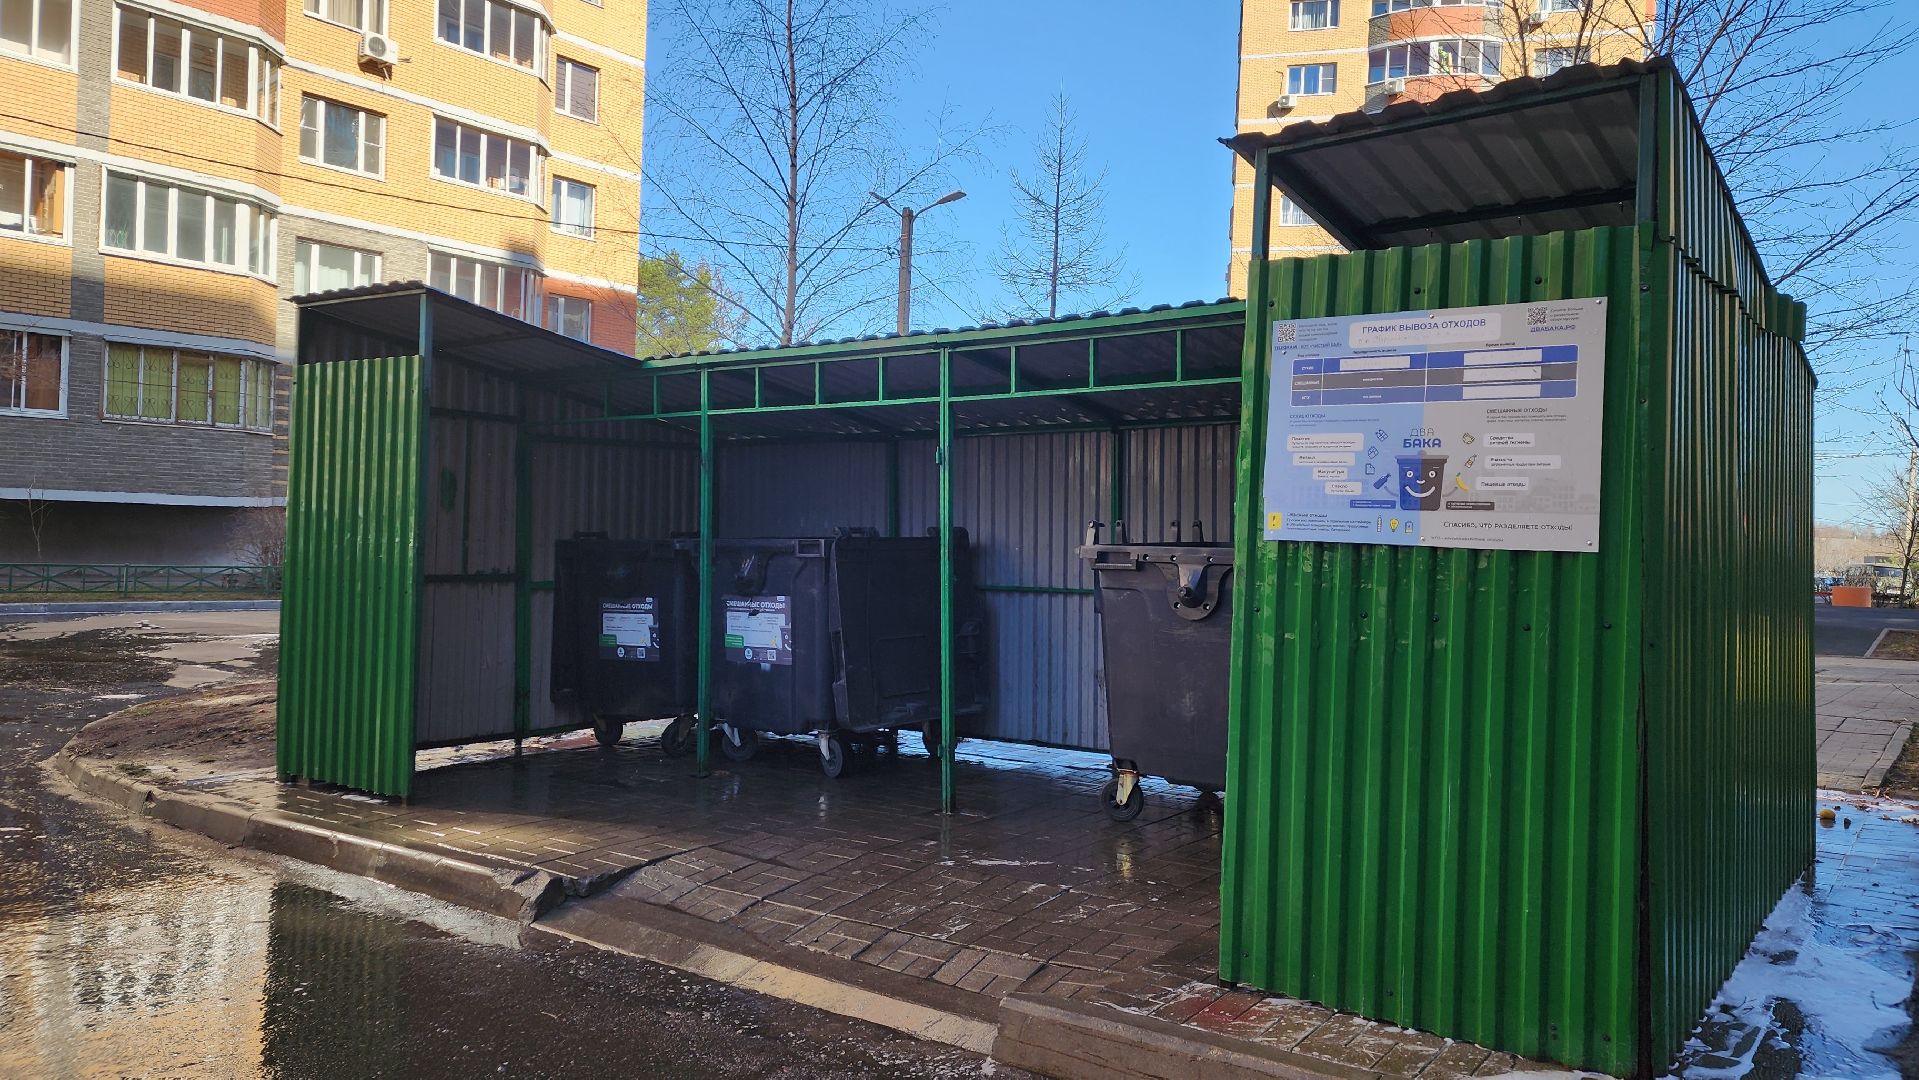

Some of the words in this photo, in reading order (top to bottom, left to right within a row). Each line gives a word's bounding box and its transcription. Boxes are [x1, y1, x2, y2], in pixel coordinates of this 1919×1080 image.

[1362, 324, 1397, 334] ГРАФИК
[1399, 323, 1440, 332] ВЫВОЗА
[1441, 318, 1486, 330] ОТХОДОВ
[1410, 428, 1435, 437] ДВА
[1402, 438, 1442, 448] БАКА
